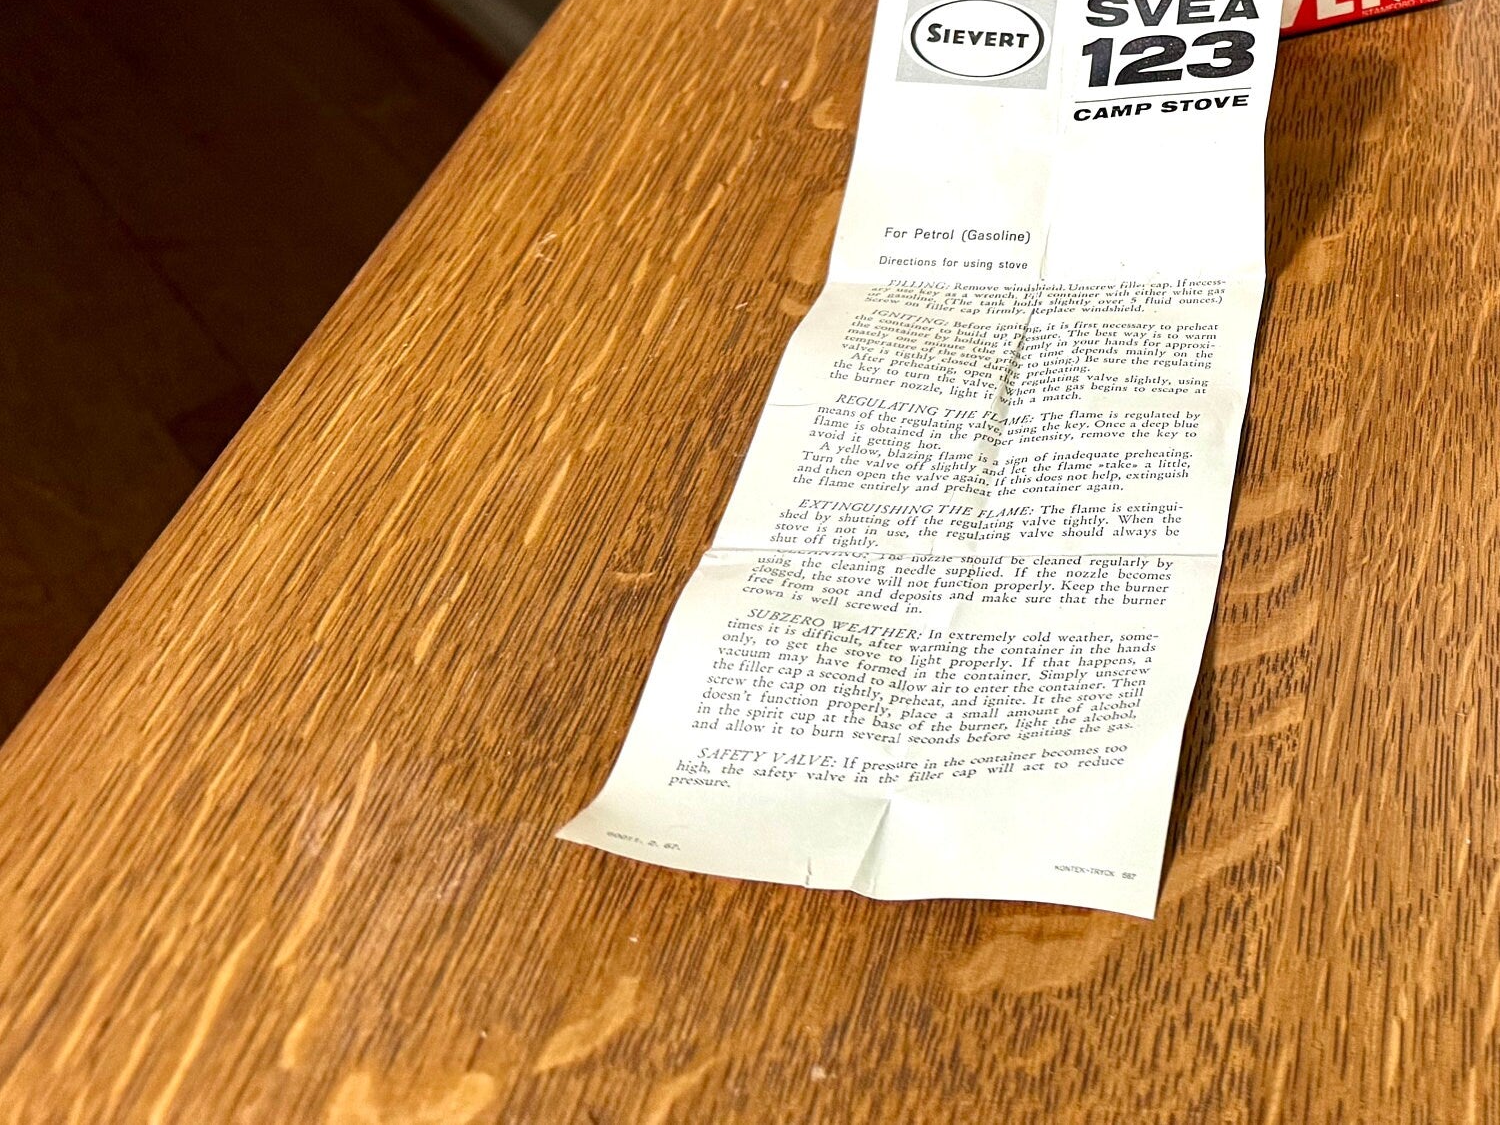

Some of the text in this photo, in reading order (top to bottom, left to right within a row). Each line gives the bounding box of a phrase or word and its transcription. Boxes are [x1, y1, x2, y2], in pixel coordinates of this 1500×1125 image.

[926, 23, 1030, 49] SIEVERT
[1081, 29, 1256, 88] 123
[1073, 94, 1251, 122] CAMP STOVE
[884, 227, 1032, 245] For Petrol (Gasoline)
[879, 255, 1029, 271] Directions for using stove
[829, 369, 849, 380] the
[853, 371, 896, 387] burner
[949, 384, 978, 399] light
[983, 389, 994, 400] it
[1029, 396, 1037, 404] a
[817, 406, 856, 418] means
[858, 409, 875, 420] of
[877, 410, 897, 423] the
[900, 417, 964, 429] regulating
[1006, 424, 1038, 436] using
[1041, 421, 1061, 432] the
[1093, 419, 1126, 428] Once
[1140, 419, 1170, 430] deep
[1173, 419, 1200, 429] blue
[834, 393, 939, 416] REGULATING
[943, 407, 979, 419] THE
[1039, 411, 1064, 422] The
[1068, 409, 1104, 419] flame
[1108, 410, 1119, 419] is
[1124, 410, 1181, 421] regulated
[1185, 410, 1201, 421] by
[808, 429, 846, 441] avoid
[850, 431, 862, 443] it
[866, 436, 911, 451] getting
[813, 415, 850, 429] flame
[854, 420, 865, 431] is
[869, 422, 925, 438] obtained
[929, 429, 942, 439] in
[948, 427, 969, 440] the
[972, 432, 1014, 447] proper
[1080, 431, 1126, 439] remove
[1131, 428, 1150, 438] the
[1156, 428, 1179, 440] key
[779, 508, 809, 520] shed
[814, 510, 832, 524] by
[837, 512, 891, 528] shutting
[896, 515, 919, 526] off
[923, 514, 944, 526] the
[949, 518, 1015, 530] regulating
[1021, 516, 1057, 527] valve
[1117, 513, 1154, 524] When
[1161, 513, 1182, 524] the
[797, 498, 934, 515] EXTINGUISHING
[937, 504, 974, 516] THE
[1039, 504, 1066, 515] The
[1070, 503, 1107, 514] flame
[1111, 502, 1122, 513] is
[769, 531, 798, 543] shut
[803, 533, 826, 545] off
[775, 523, 809, 532] stove
[816, 522, 828, 533] is
[834, 526, 857, 534] not
[864, 525, 878, 536] in
[917, 526, 939, 537] the
[945, 529, 1012, 542] regulating
[1019, 527, 1055, 538] valve
[1061, 526, 1105, 538] should
[1112, 525, 1158, 539] always
[1164, 524, 1180, 537] be
[780, 575, 814, 592] from
[821, 587, 850, 596] soot
[856, 587, 884, 599] and
[889, 589, 943, 604] deposits
[948, 590, 975, 602] and
[981, 591, 1018, 603] make
[1024, 595, 1052, 604] sure
[1059, 592, 1087, 604] that
[1093, 593, 1115, 605] the
[1121, 593, 1167, 605] burner
[727, 617, 763, 632] times
[767, 622, 780, 634] it
[784, 624, 797, 636] is
[867, 637, 903, 651] after
[909, 643, 968, 657] warming
[973, 642, 995, 655] the
[1000, 643, 1065, 655] container
[1069, 644, 1084, 655] in
[1089, 643, 1111, 655] the
[1116, 641, 1157, 654] hands
[746, 608, 826, 628] SUBZERO
[927, 629, 943, 640] In
[948, 631, 1017, 645] extremely
[1021, 630, 1052, 643] cold
[696, 747, 767, 762] SAFETY
[842, 756, 859, 769] If
[923, 758, 938, 770] in
[943, 756, 966, 767] the
[969, 751, 1037, 765] container
[1041, 747, 1100, 759] becomes
[1104, 744, 1128, 754] too
